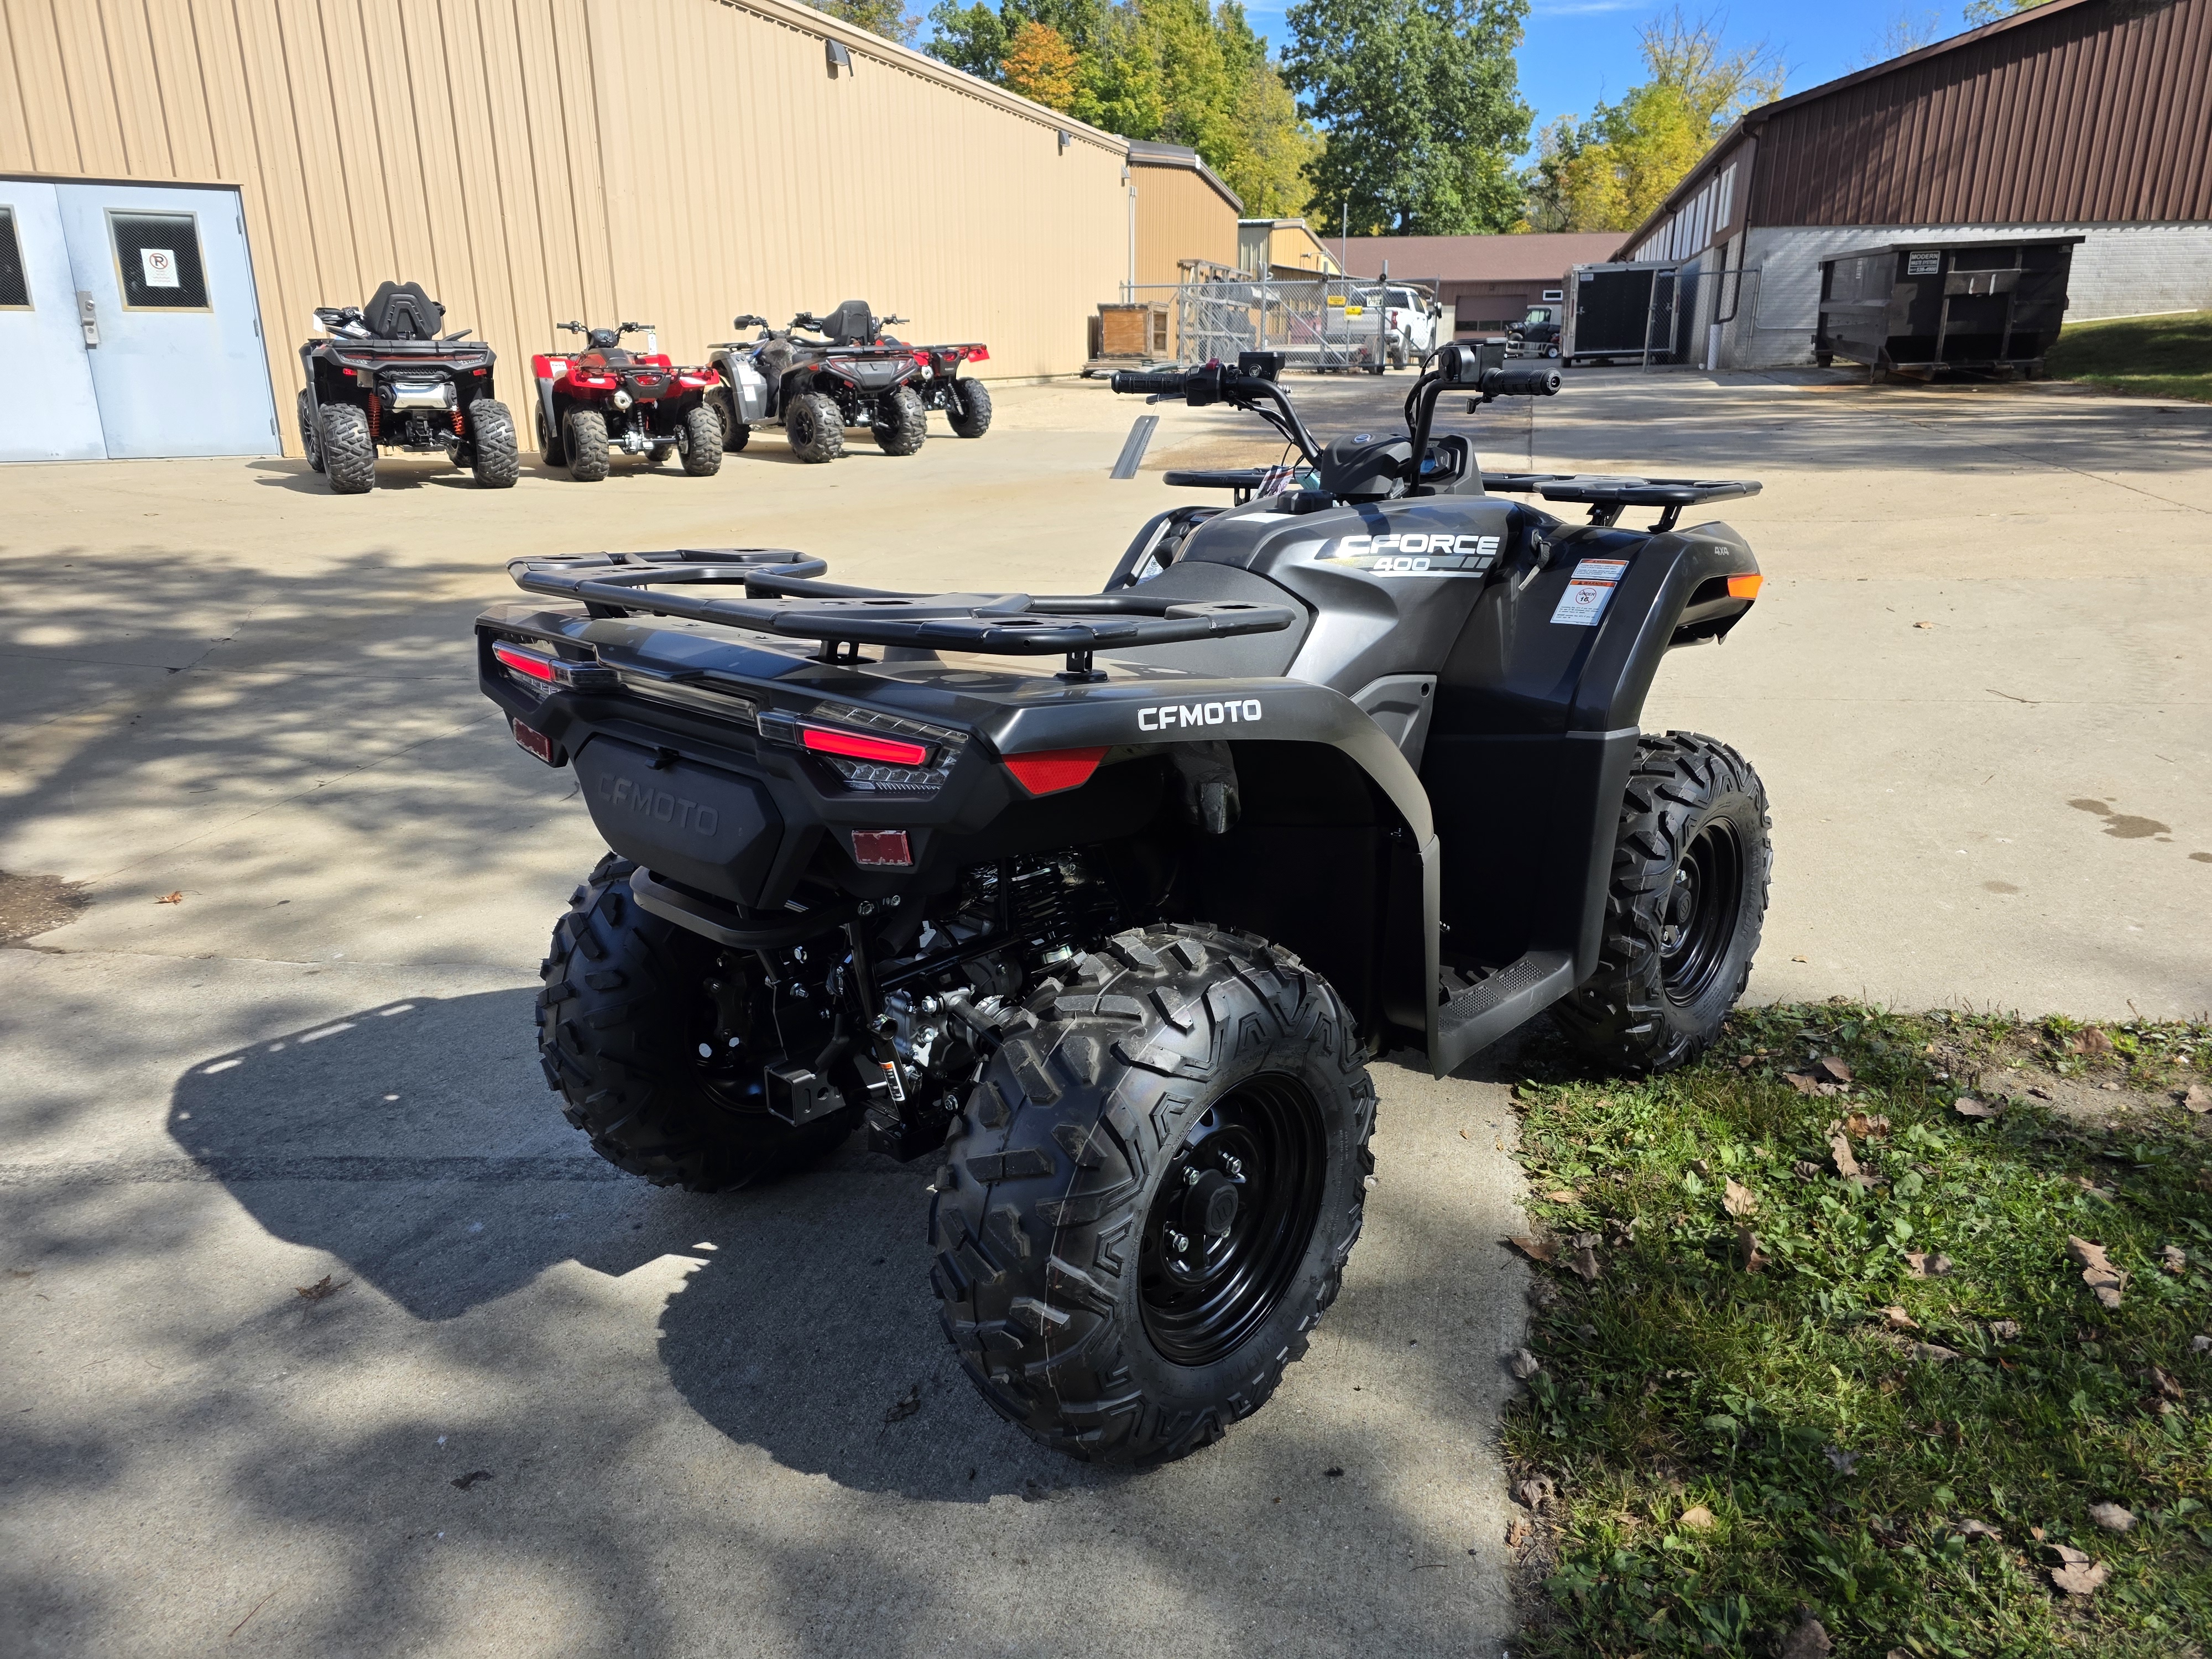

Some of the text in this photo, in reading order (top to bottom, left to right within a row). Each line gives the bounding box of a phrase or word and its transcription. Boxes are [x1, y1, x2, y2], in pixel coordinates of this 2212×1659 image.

[1336, 534, 1500, 557] CFORCE
[1373, 557, 1431, 571] 400
[1138, 699, 1261, 731] CFMOTO
[598, 774, 719, 837] CFMOTO
